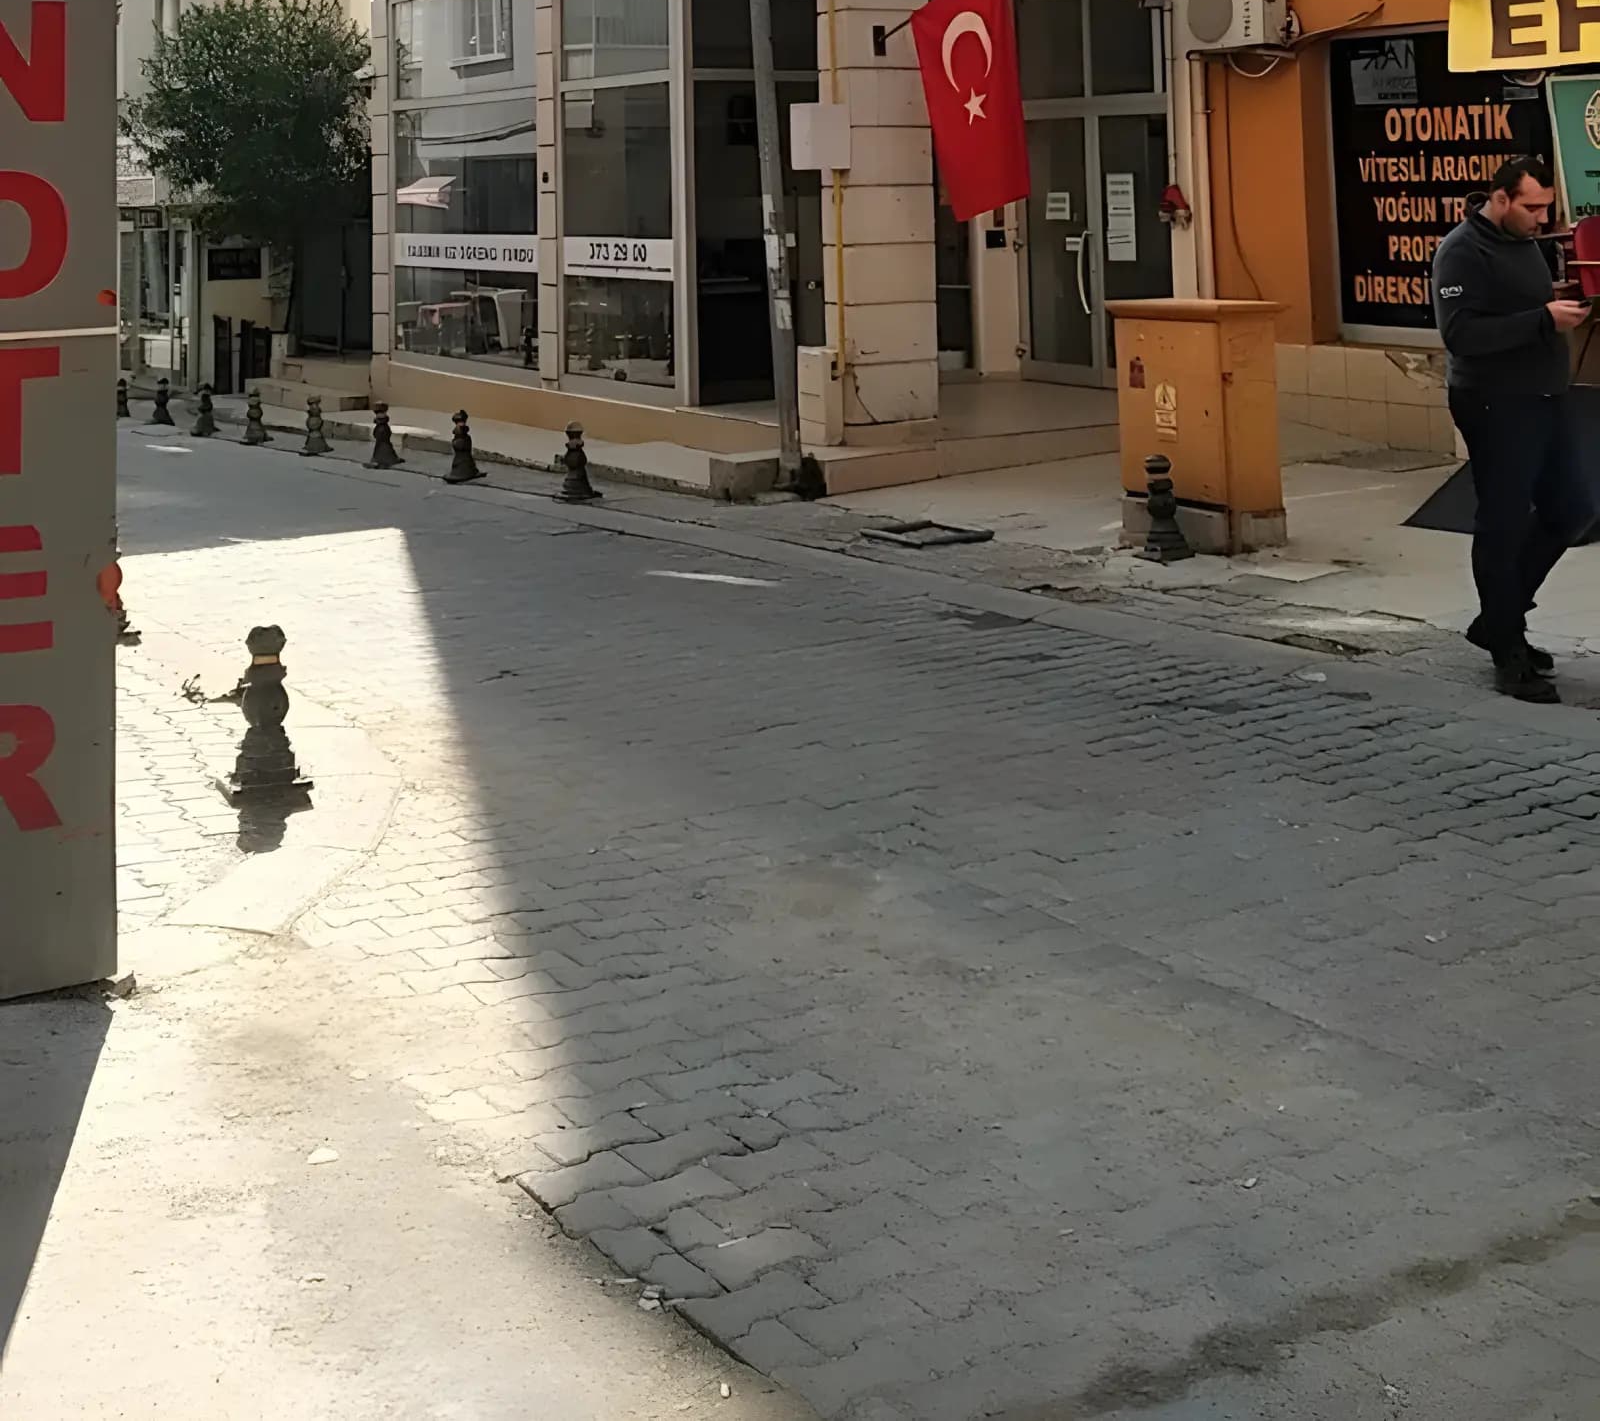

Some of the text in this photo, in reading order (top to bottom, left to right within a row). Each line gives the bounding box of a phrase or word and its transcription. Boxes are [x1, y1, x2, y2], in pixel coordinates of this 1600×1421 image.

[1384, 96, 1513, 142] OTOMATİK
[1359, 149, 1427, 182] VİTESLİ
[1373, 191, 1467, 223] YOĞUN TR
[1388, 234, 1444, 263] PROF
[1353, 268, 1432, 306] DİREKSİ
